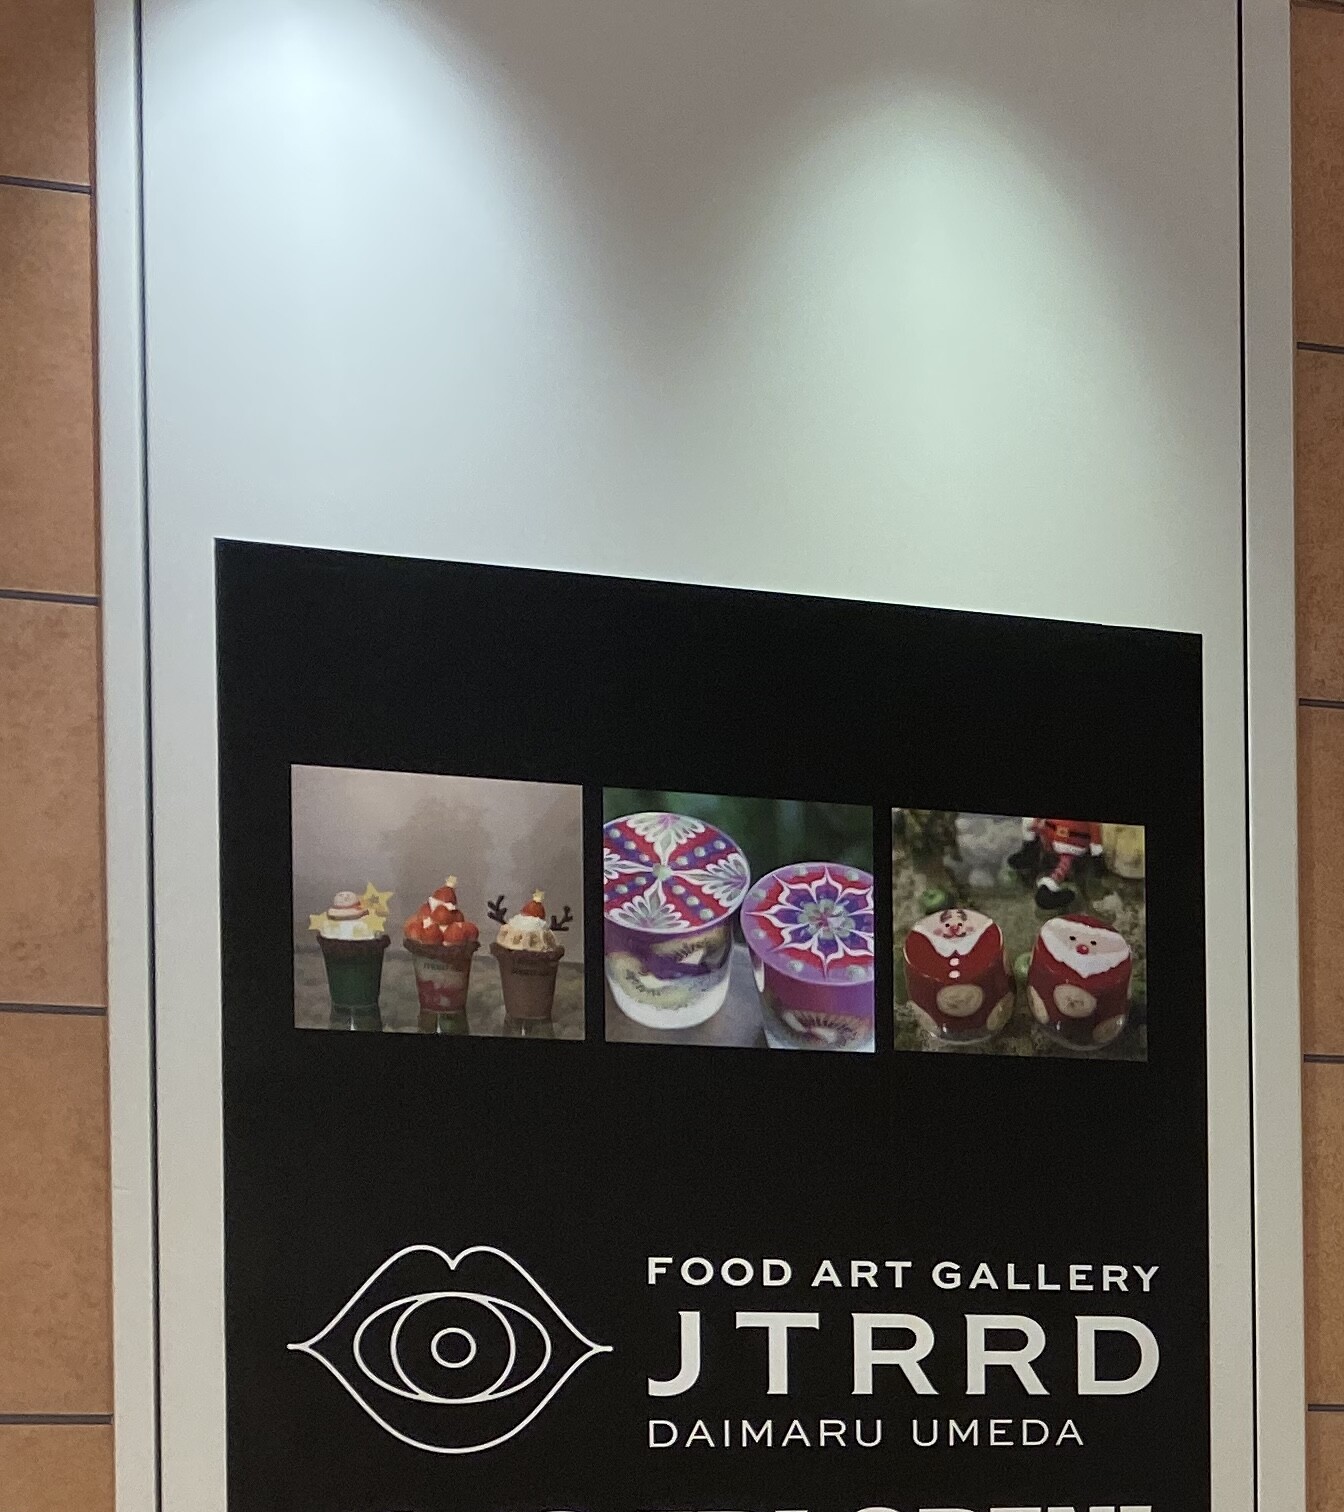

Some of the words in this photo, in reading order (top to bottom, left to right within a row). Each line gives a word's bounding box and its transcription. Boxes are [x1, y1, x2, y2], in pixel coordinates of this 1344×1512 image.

[647, 1256, 793, 1288] FOOD
[811, 1259, 914, 1289] ART
[931, 1261, 1161, 1293] GALLERY
[646, 1311, 1162, 1398] JTRRD
[648, 1419, 884, 1449] DAIMARU
[912, 1419, 1086, 1448] UMEDA
